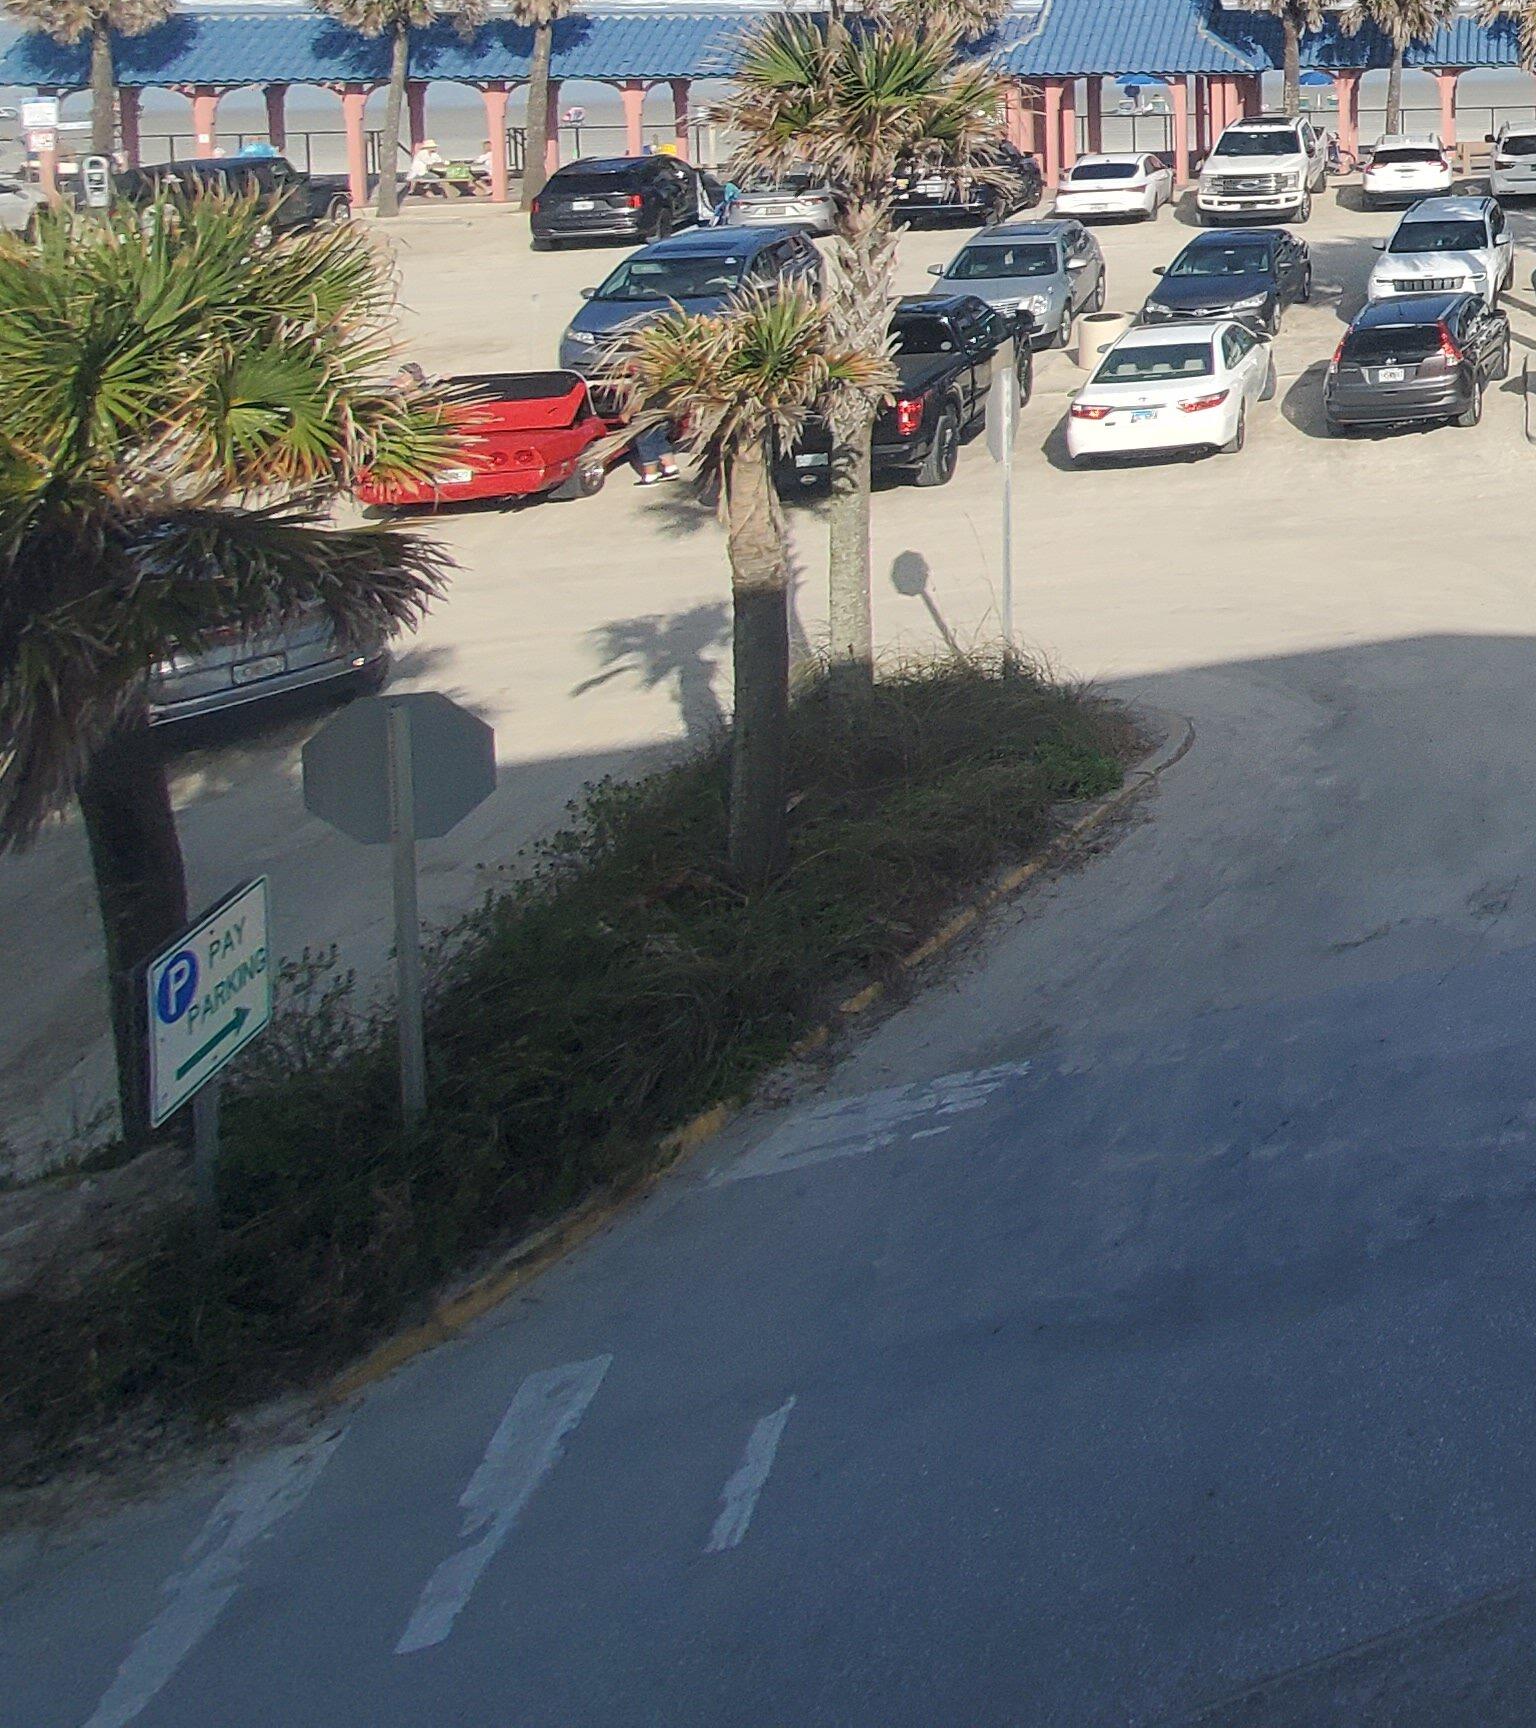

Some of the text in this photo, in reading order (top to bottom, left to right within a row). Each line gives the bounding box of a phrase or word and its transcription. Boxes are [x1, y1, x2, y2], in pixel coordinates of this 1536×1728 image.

[208, 916, 246, 969] PAY
[168, 958, 190, 1016] P
[187, 946, 268, 1034] PARKING
